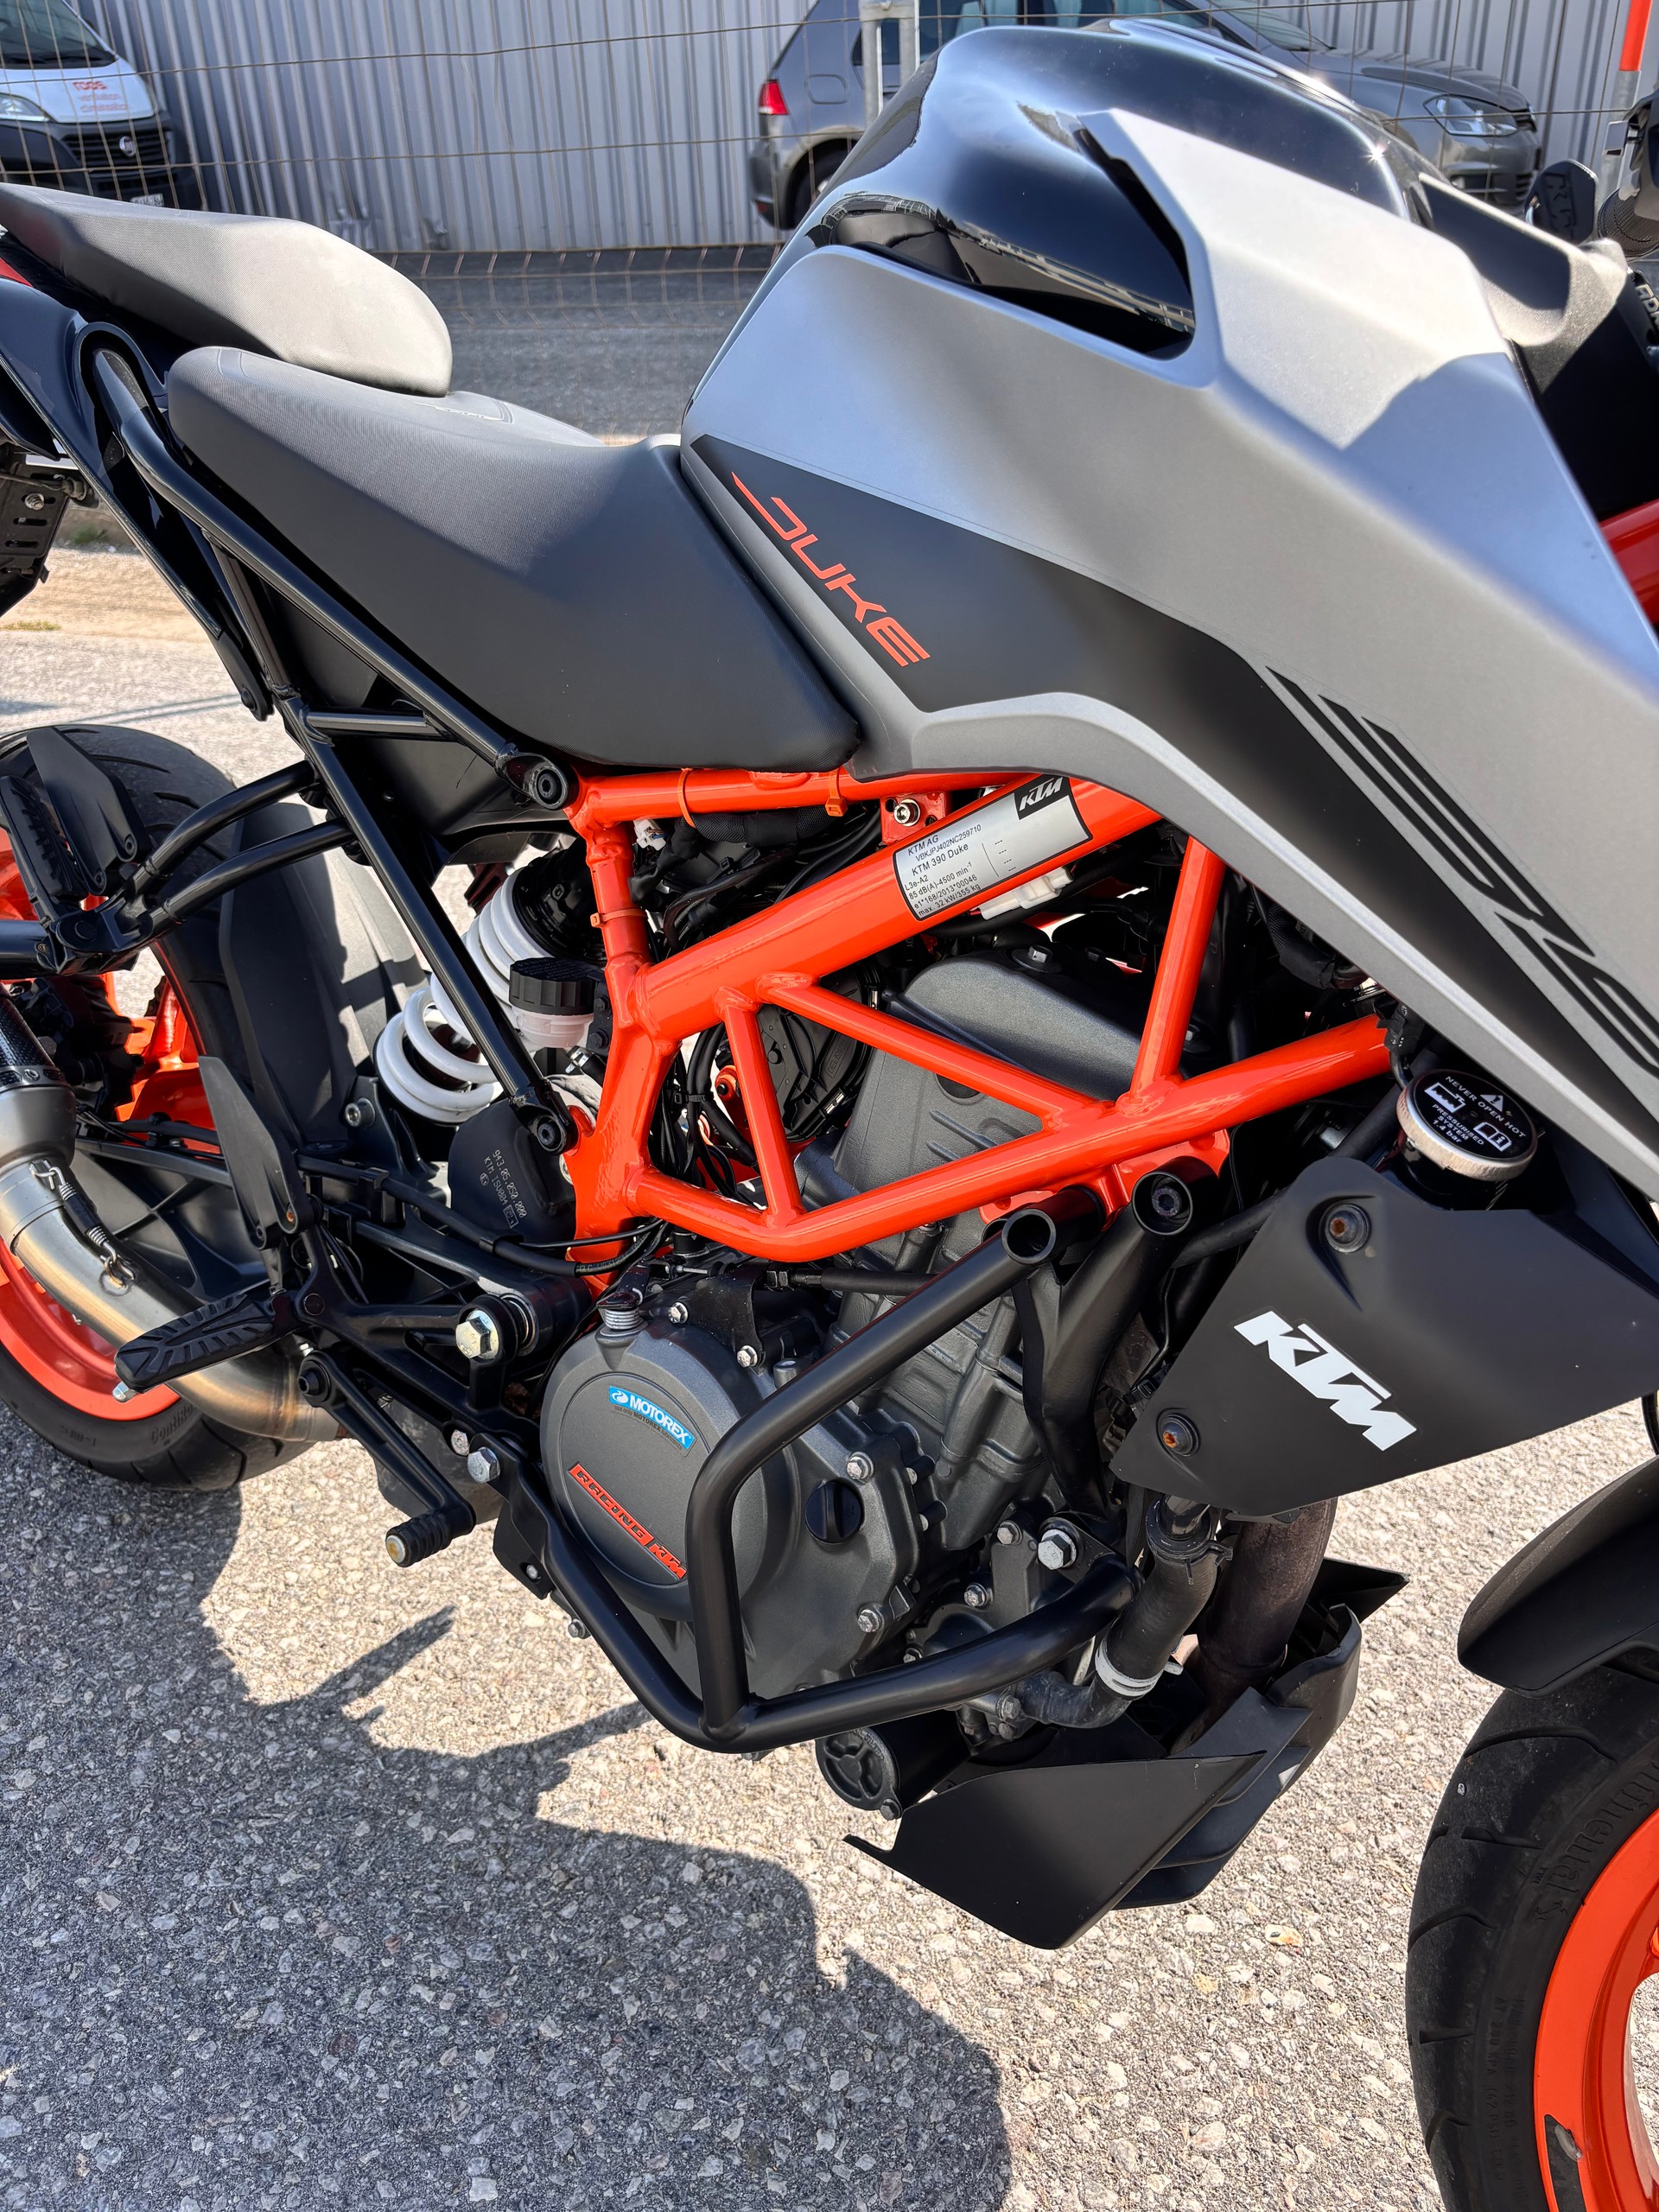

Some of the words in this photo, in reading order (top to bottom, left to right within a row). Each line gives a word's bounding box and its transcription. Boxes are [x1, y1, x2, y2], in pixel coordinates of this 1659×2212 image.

[731, 471, 931, 667] DUKE
[1019, 776, 1065, 812] KTM
[907, 840, 925, 855] KTM
[926, 834, 939, 846] AG
[912, 861, 931, 876] KTM
[931, 853, 946, 867] 390
[947, 843, 969, 858] Duke
[904, 874, 929, 891] L3e-A2
[908, 890, 918, 900] 85
[918, 905, 935, 916] max.
[935, 899, 944, 908] 32
[945, 887, 970, 903] kW/355
[971, 883, 982, 892] kg
[1446, 1076, 1477, 1102] NEVER
[1478, 1101, 1505, 1122] OPEN
[1504, 1121, 1527, 1138] HOT
[1432, 1103, 1485, 1146] PRESSURISED
[1433, 1119, 1446, 1131] 1.4
[1446, 1129, 1463, 1143] bar
[1437, 1116, 1469, 1141] SYSTEM
[484, 1156, 495, 1174] KTM
[493, 1149, 527, 1218] 943.05.050.000
[1234, 1310, 1417, 1451] KTM
[629, 1394, 690, 1445] MOTOREX
[633, 1411, 661, 1432] MOTOREX
[576, 1471, 645, 1539] RACING
[648, 1542, 687, 1580] KTM
